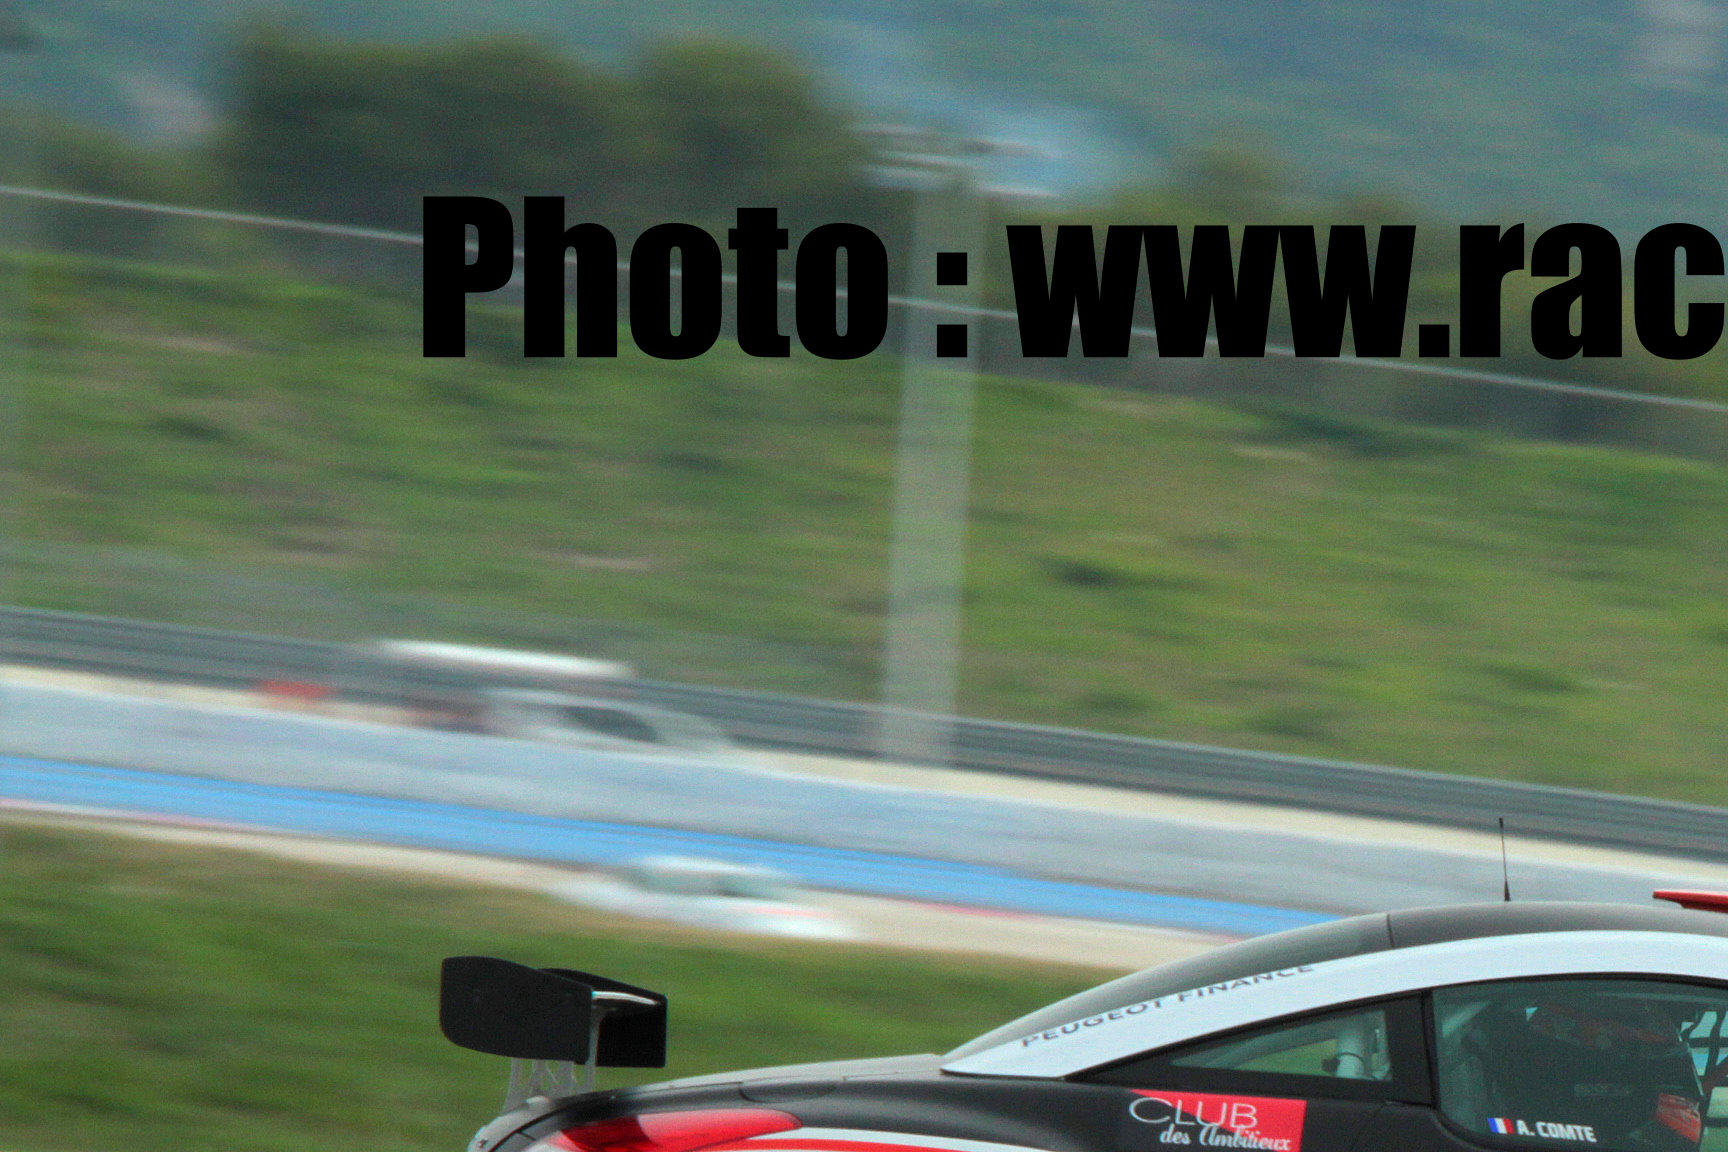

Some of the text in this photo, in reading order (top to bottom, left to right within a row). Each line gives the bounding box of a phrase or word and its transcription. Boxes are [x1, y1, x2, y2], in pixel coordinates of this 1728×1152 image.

[1021, 964, 1316, 1047] PEUGEOT FINANCE
[1128, 1096, 1259, 1129] CLUB
[1159, 1123, 1293, 1151] des Ambitieux
[1516, 1119, 1598, 1143] A. COMTE
